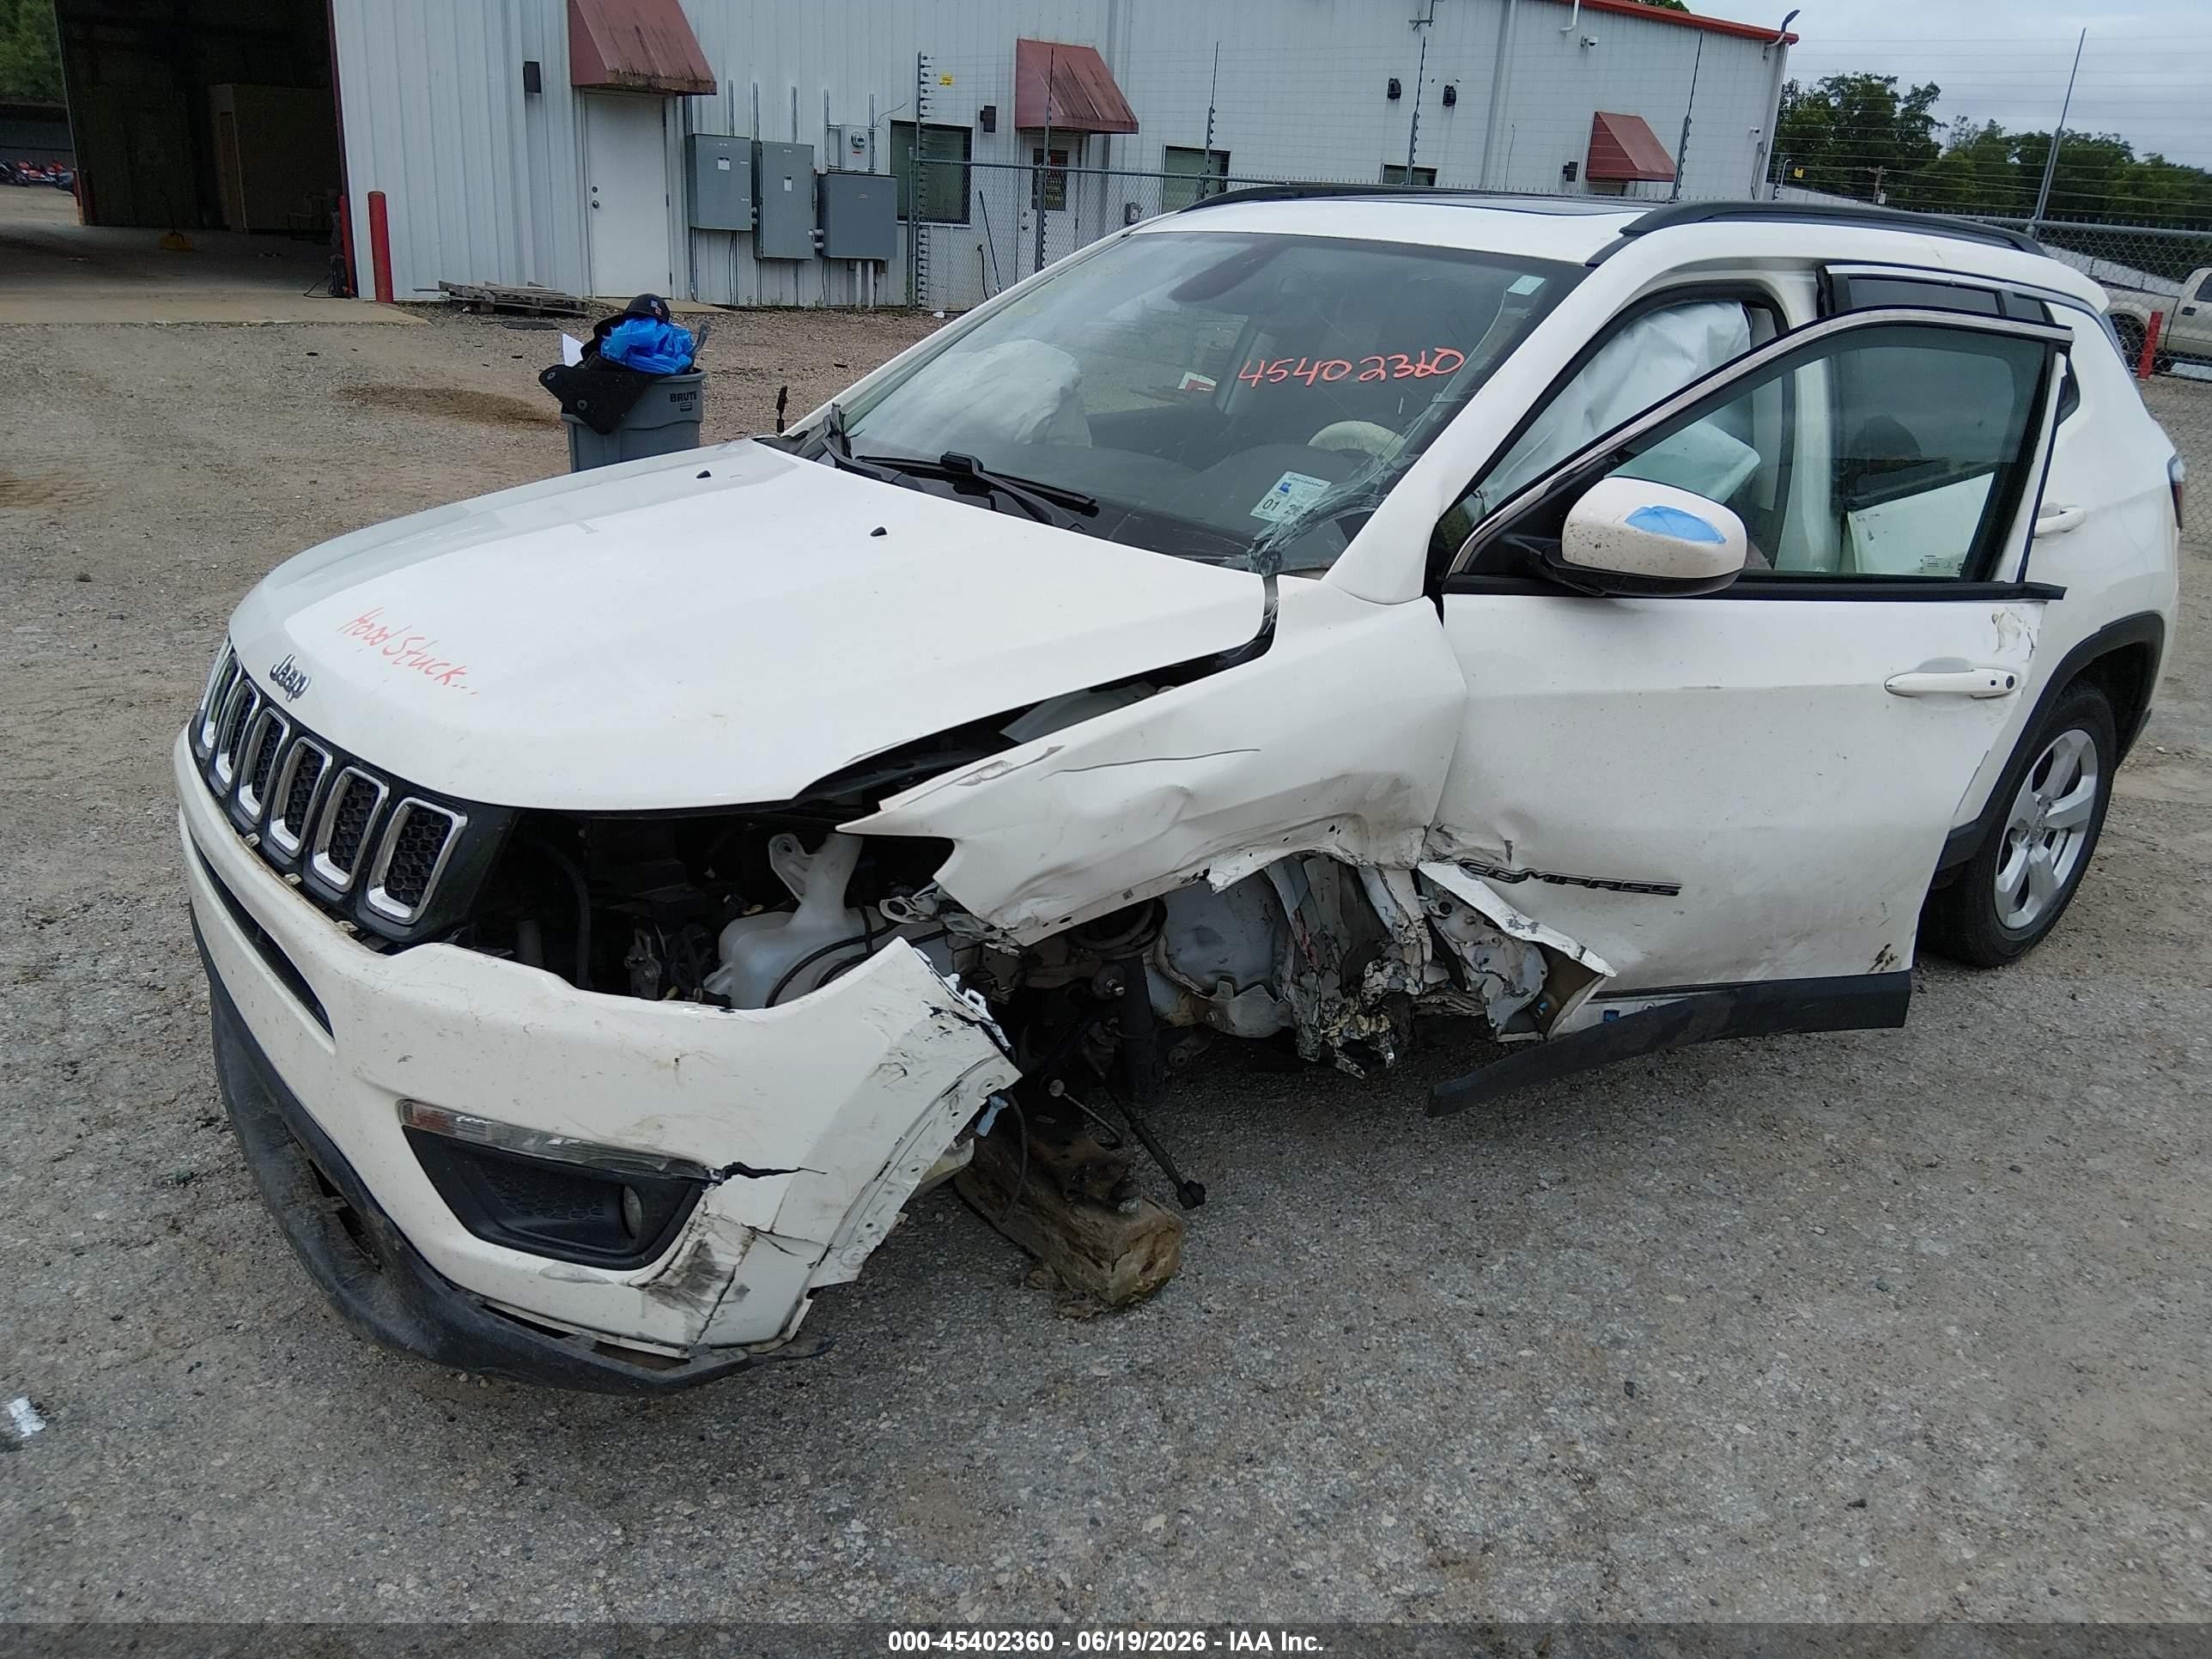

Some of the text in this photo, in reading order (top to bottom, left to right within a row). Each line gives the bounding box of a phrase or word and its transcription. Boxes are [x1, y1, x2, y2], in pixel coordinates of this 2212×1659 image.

[670, 391, 697, 403] BRUTE
[1262, 498, 1280, 512] 01
[270, 653, 311, 702] Jeep
[1457, 858, 1682, 896] COMPASS
